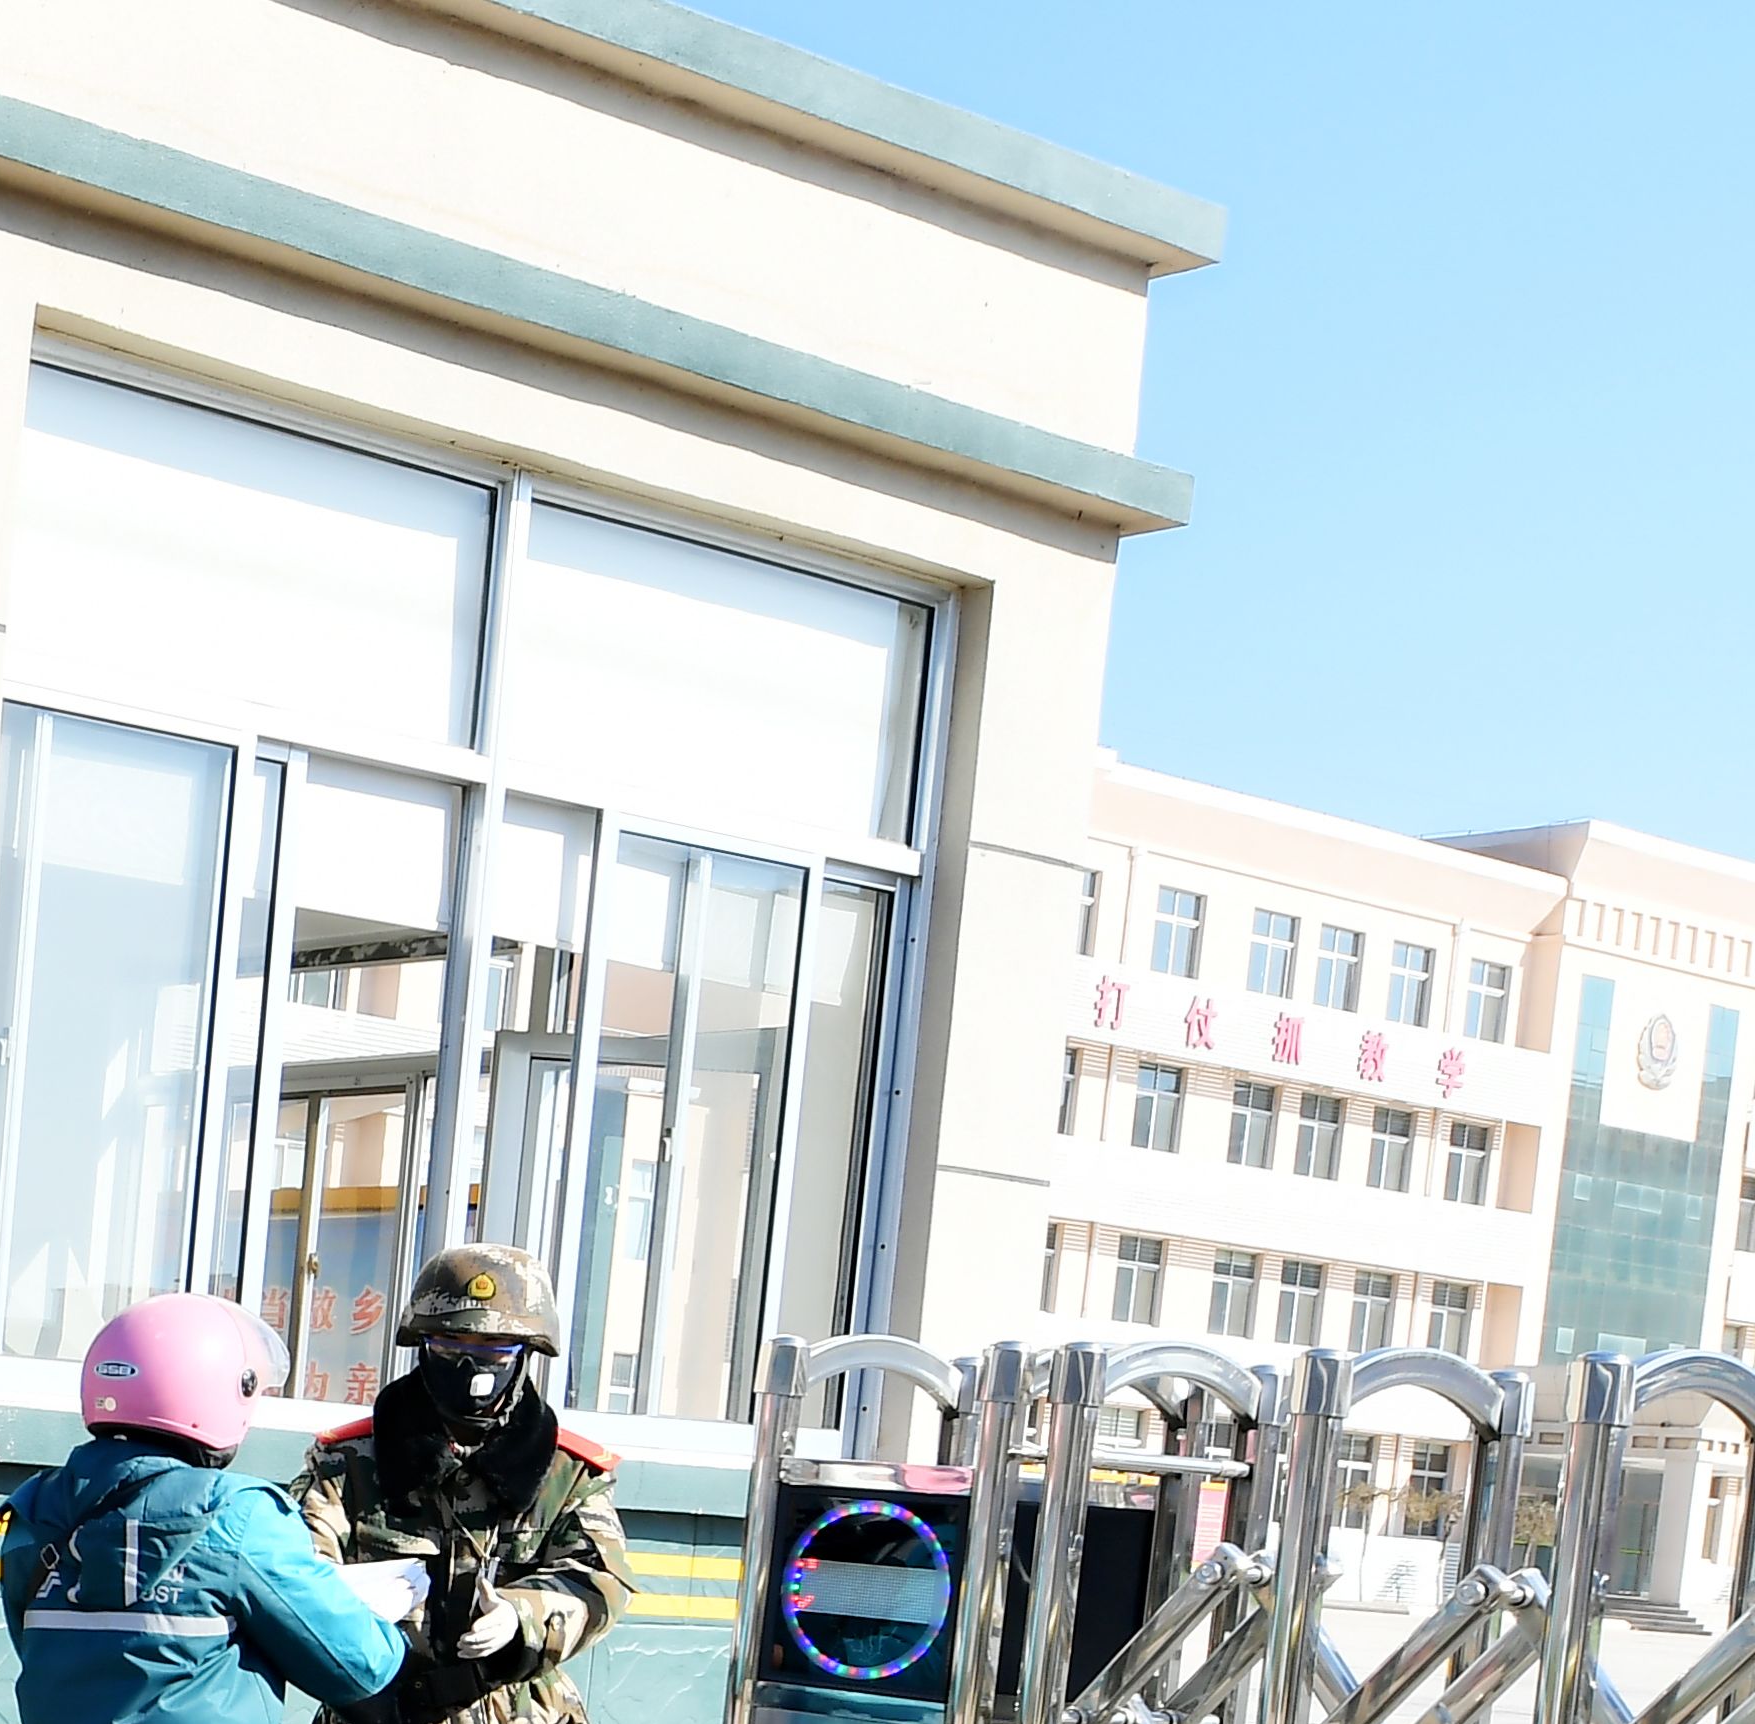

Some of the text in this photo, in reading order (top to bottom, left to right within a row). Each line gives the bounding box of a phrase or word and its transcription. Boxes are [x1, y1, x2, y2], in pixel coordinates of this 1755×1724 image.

[1093, 973, 1468, 1099] 打仗抓教学
